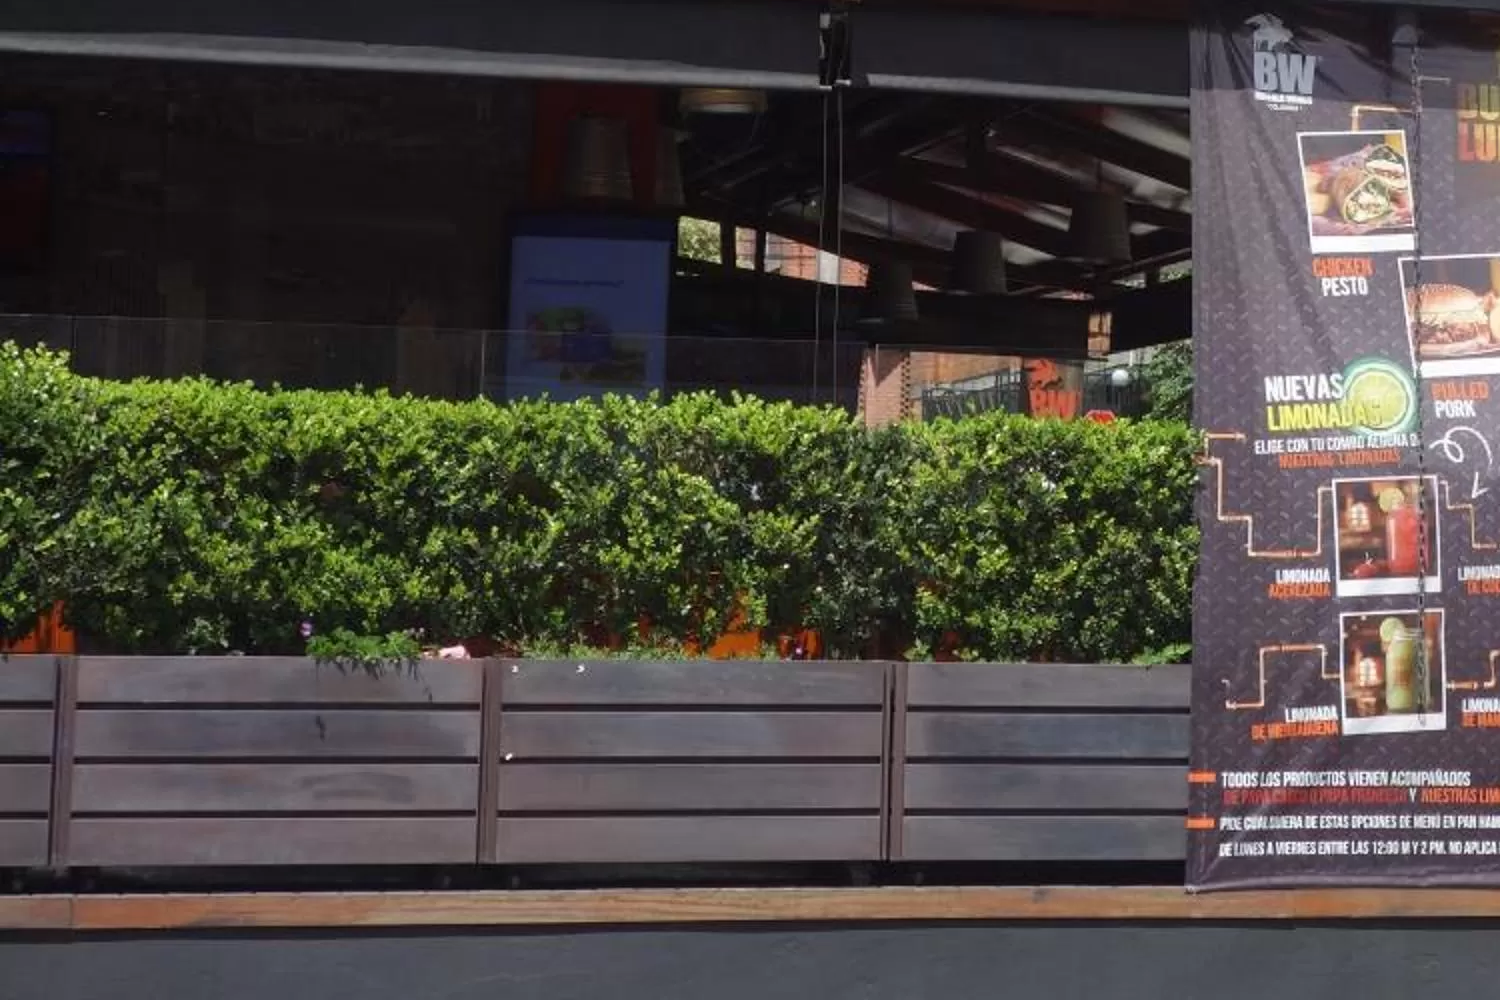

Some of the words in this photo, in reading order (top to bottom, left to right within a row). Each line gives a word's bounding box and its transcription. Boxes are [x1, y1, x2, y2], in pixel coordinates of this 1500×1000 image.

[1253, 51, 1316, 94] BW
[1321, 276, 1369, 297] PESTO
[1264, 373, 1345, 402] NUEVAS
[1266, 399, 1383, 432] LIMONADAS
[1435, 399, 1477, 418] PORK
[1275, 567, 1331, 583] LIMONADA
[1285, 705, 1338, 723] LIMONADA
[1221, 771, 1258, 788] TODOS
[1260, 772, 1280, 787] LOS
[1283, 771, 1346, 787] PRODUCTOS
[1348, 771, 1388, 786] VIENEN
[1390, 769, 1471, 787] ACOMPAÑADOS
[1409, 787, 1417, 802] Y
[1421, 788, 1477, 803] NUESTRAS
[1220, 816, 1242, 830] PIDE
[1304, 815, 1318, 829] DE
[1320, 815, 1349, 829] ESTAS
[1351, 815, 1397, 829] OPCIONES
[1399, 815, 1413, 829] DE
[1443, 815, 1456, 829] EN
[1457, 815, 1477, 829] PAN
[1219, 843, 1232, 857] DE
[1233, 842, 1265, 856] LUNES
[1266, 841, 1275, 855] A
[1275, 841, 1317, 855] VIERNES
[1318, 841, 1349, 855] ENTRE
[1351, 841, 1370, 855] LAS
[1411, 841, 1420, 855] Y
[1420, 841, 1428, 855] 2
[1448, 841, 1463, 855] NO
[1463, 841, 1497, 855] APLICA
